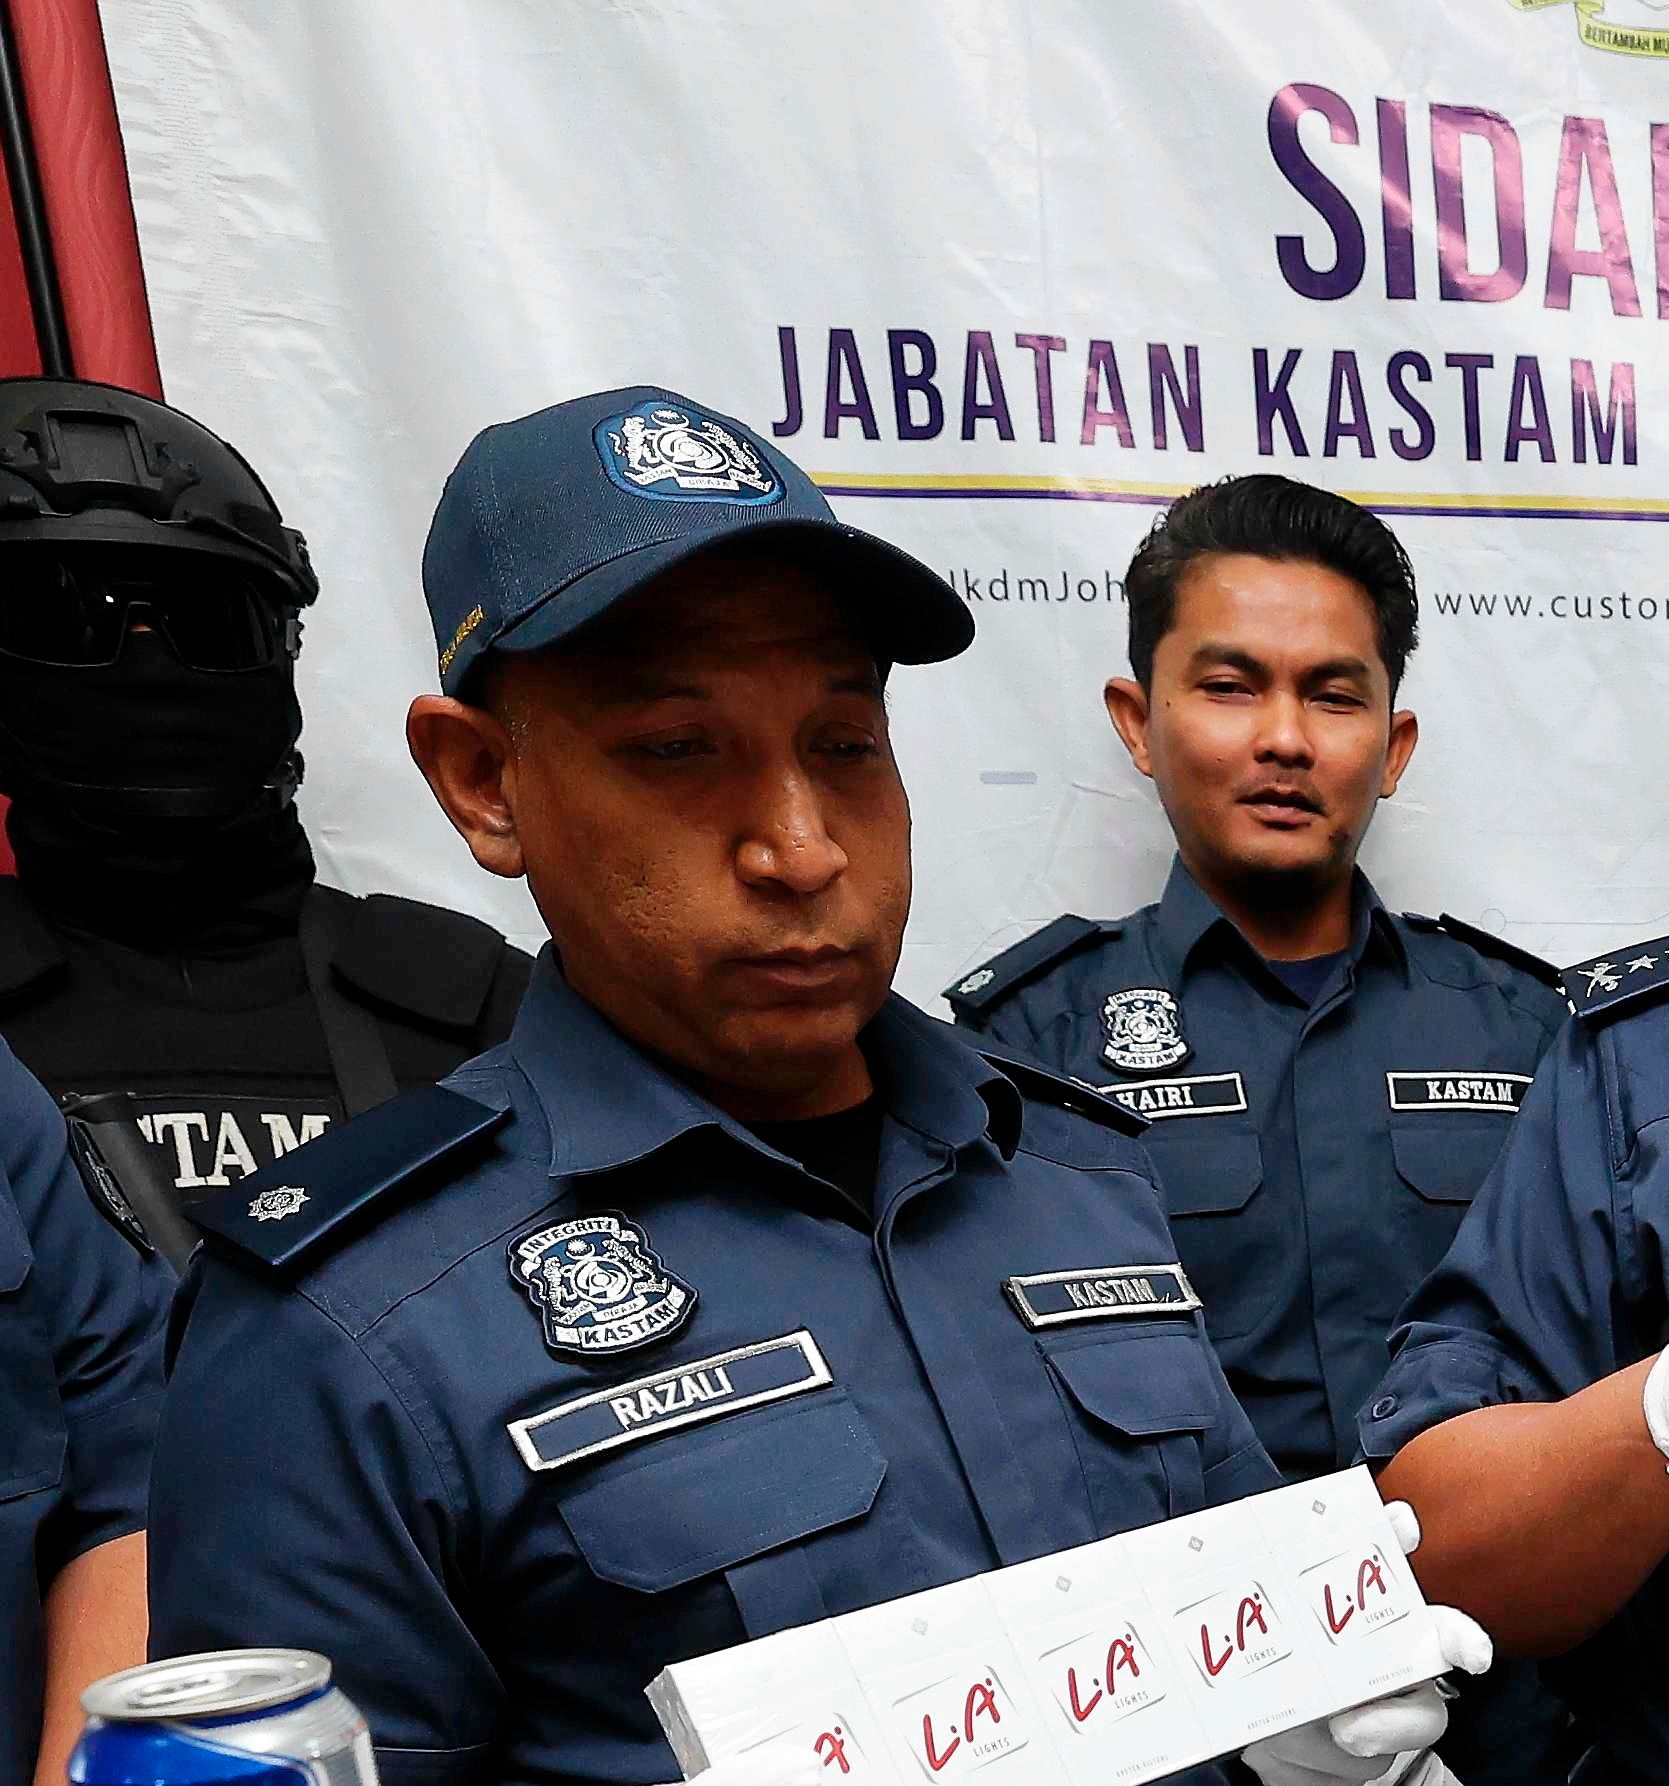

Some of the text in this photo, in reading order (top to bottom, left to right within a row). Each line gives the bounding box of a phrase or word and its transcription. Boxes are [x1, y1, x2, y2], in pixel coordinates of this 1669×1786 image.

[770, 324, 1205, 455] JABATAN
[1250, 346, 1638, 467] KASTAM
[1118, 1052, 1176, 1066] KASTAM
[1427, 1081, 1514, 1104] KASTAM
[524, 1220, 613, 1253] INTEGRITI
[1063, 1276, 1159, 1308] KASTAM
[584, 1302, 677, 1344] KASTAM
[609, 1366, 734, 1432] RAZALI
[1365, 1608, 1395, 1624] LIGHTS
[1244, 1647, 1278, 1665] LIGHTS
[1114, 1690, 1149, 1710] LIGHTS
[973, 1737, 1011, 1757] LIGHTS
